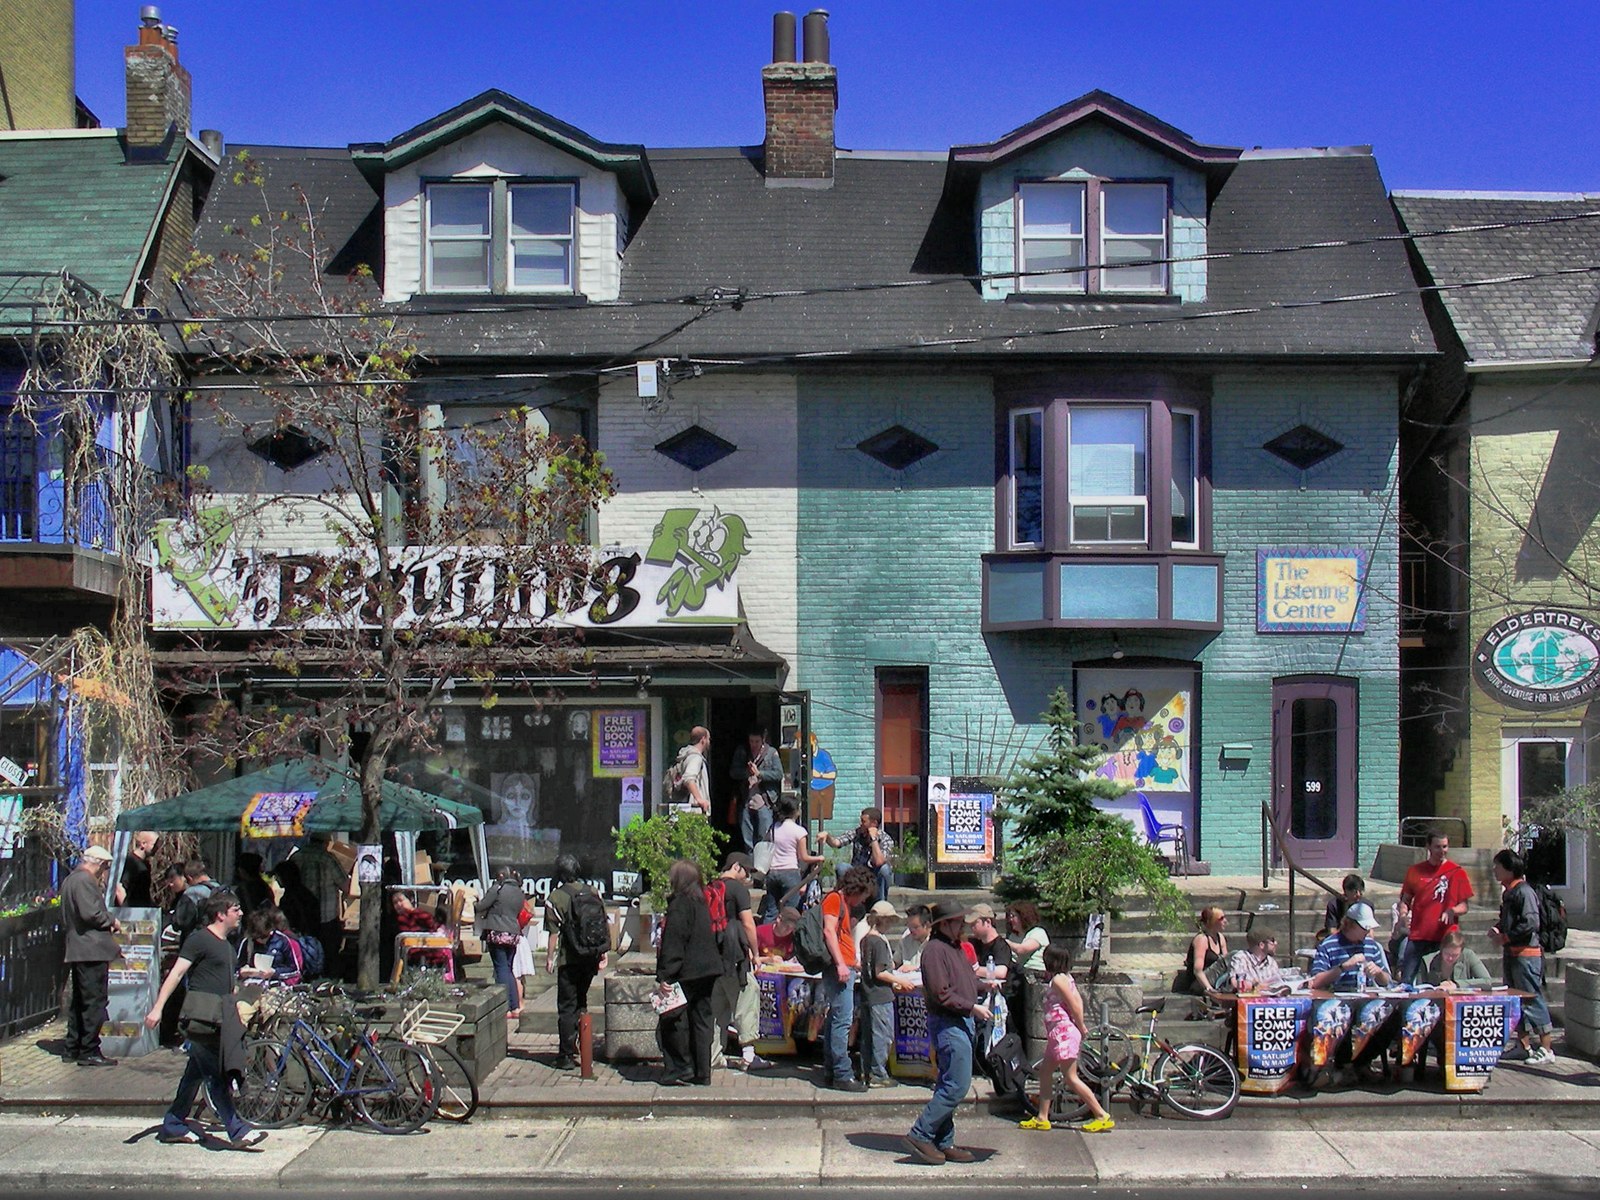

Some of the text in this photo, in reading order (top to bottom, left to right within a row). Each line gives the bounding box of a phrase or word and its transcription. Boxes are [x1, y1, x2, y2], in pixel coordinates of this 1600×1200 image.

[1275, 562, 1309, 580] The
[1274, 582, 1349, 604] Listening
[1273, 600, 1335, 619] Centre
[1485, 612, 1600, 646] ELDERTREKS
[1534, 691, 1548, 703] FOR
[604, 716, 634, 725] FREE
[604, 725, 634, 733] COMIC
[604, 733, 634, 741] BOOK
[609, 740, 629, 748] DAY
[1305, 781, 1321, 793] 599
[950, 799, 981, 810] FREE
[949, 809, 981, 817] COMIC
[949, 817, 981, 825] BOOK
[898, 996, 927, 1009] FREE
[898, 1008, 928, 1019] COMIC
[1254, 1007, 1296, 1020] FREE
[1463, 1004, 1503, 1017] FREE
[900, 1018, 928, 1030] BOOK
[1254, 1019, 1295, 1030] COMIC
[1462, 1017, 1504, 1027] COMIC
[1254, 1029, 1295, 1041] BOOK
[1462, 1027, 1503, 1038] BOOK
[1262, 1041, 1289, 1051] DAY
[1469, 1038, 1497, 1048] DAY
[1252, 1067, 1268, 1075] May
